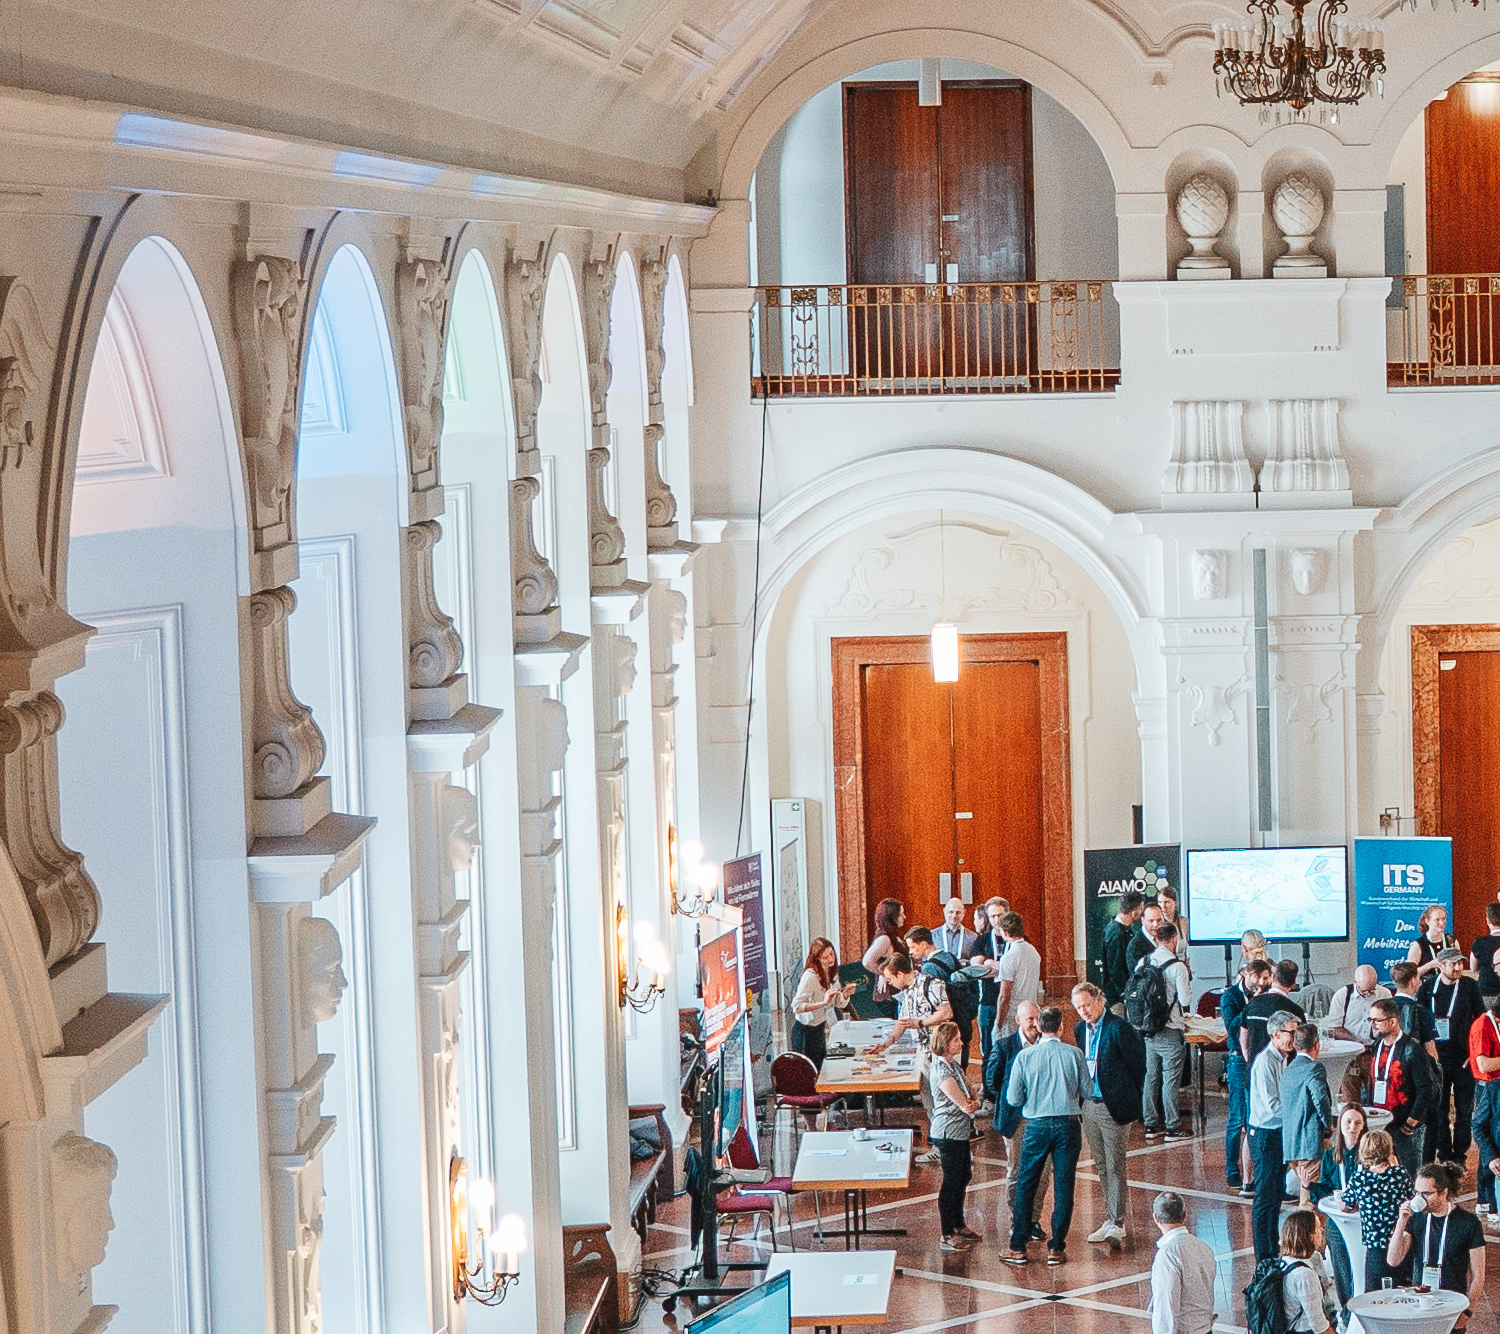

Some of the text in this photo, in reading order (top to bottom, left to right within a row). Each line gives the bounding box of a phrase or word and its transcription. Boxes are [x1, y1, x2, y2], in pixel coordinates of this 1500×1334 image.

[1382, 864, 1424, 885] ITS
[1098, 879, 1147, 893] AIAMO
[1395, 919, 1415, 932] Den
